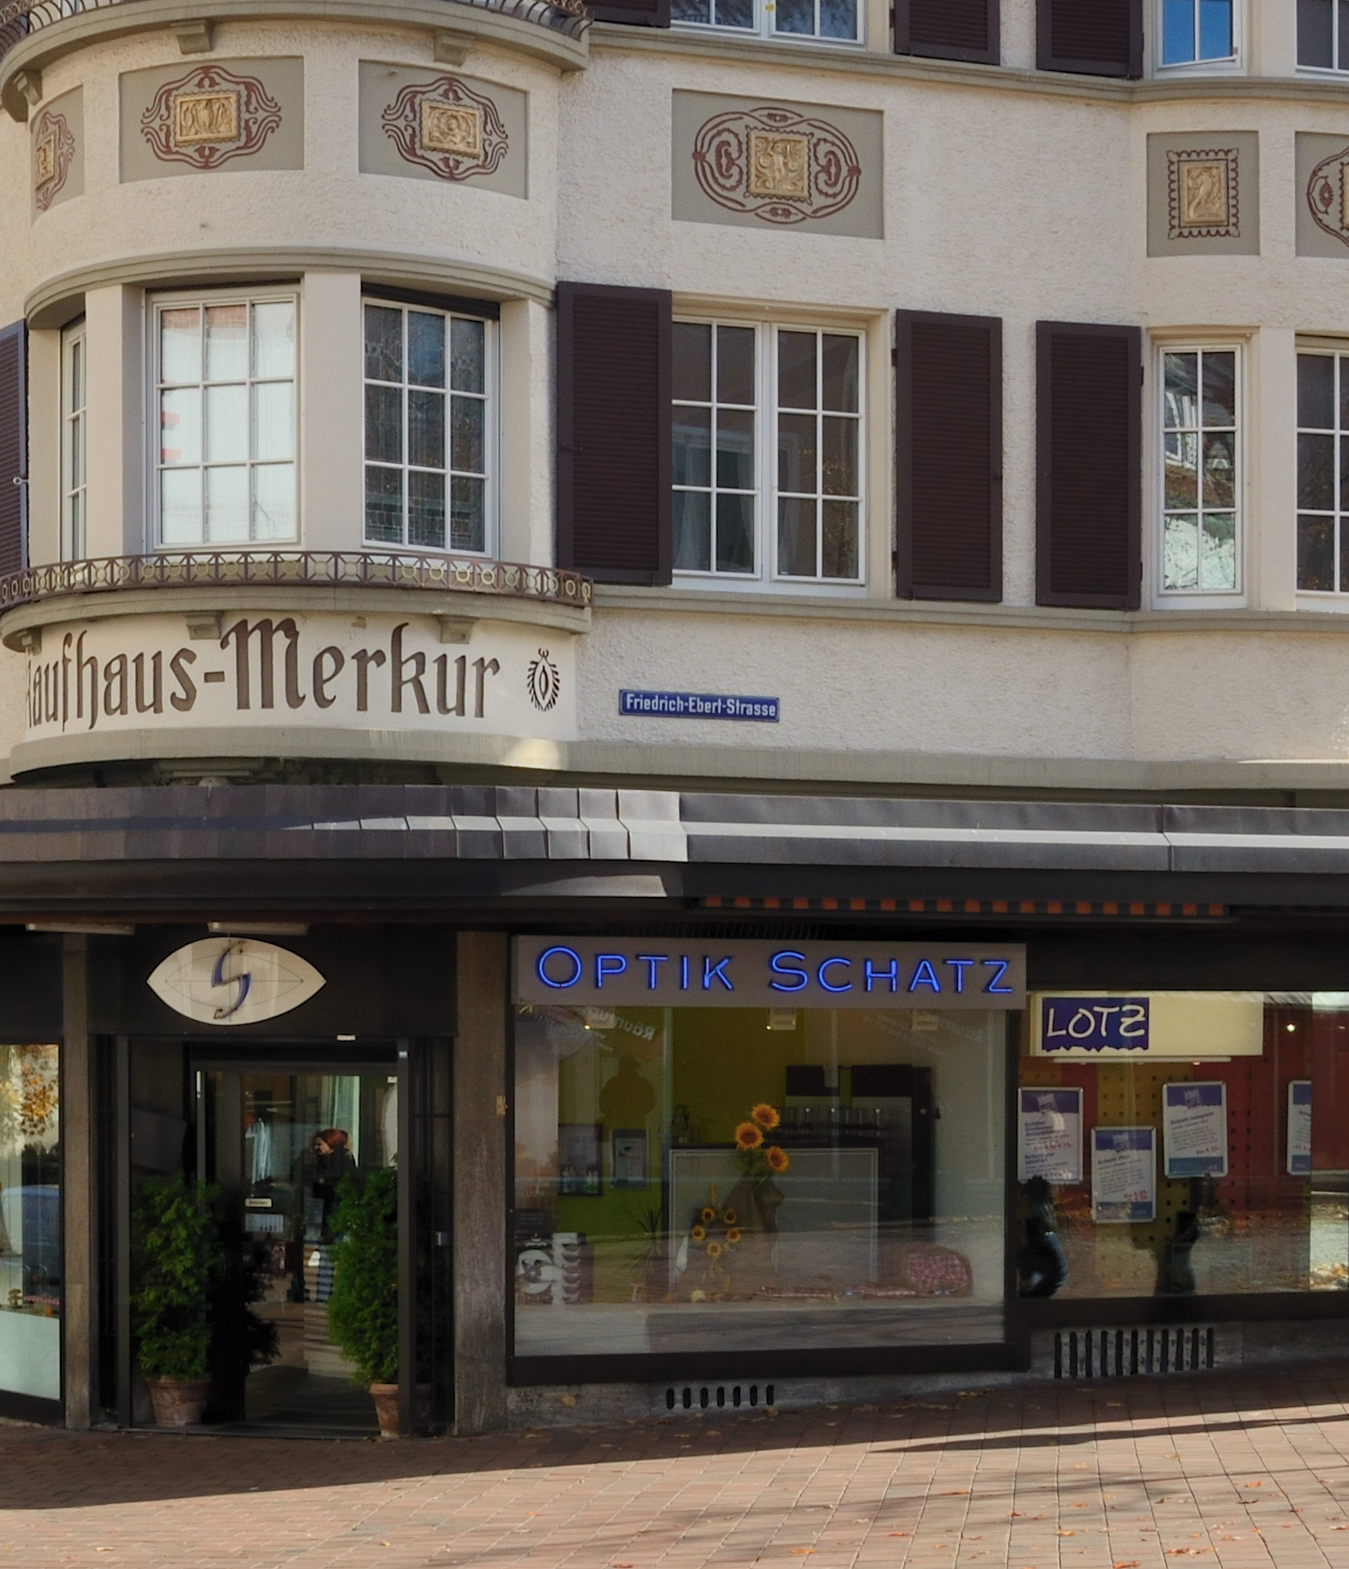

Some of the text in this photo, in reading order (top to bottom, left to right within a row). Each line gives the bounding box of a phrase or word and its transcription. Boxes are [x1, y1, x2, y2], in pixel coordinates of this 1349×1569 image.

[625, 691, 778, 720] Friedrich-Ebert-Strasse
[536, 945, 1014, 995] OPTIK SCHATZ
[1046, 1005, 1147, 1039] LOTZ
